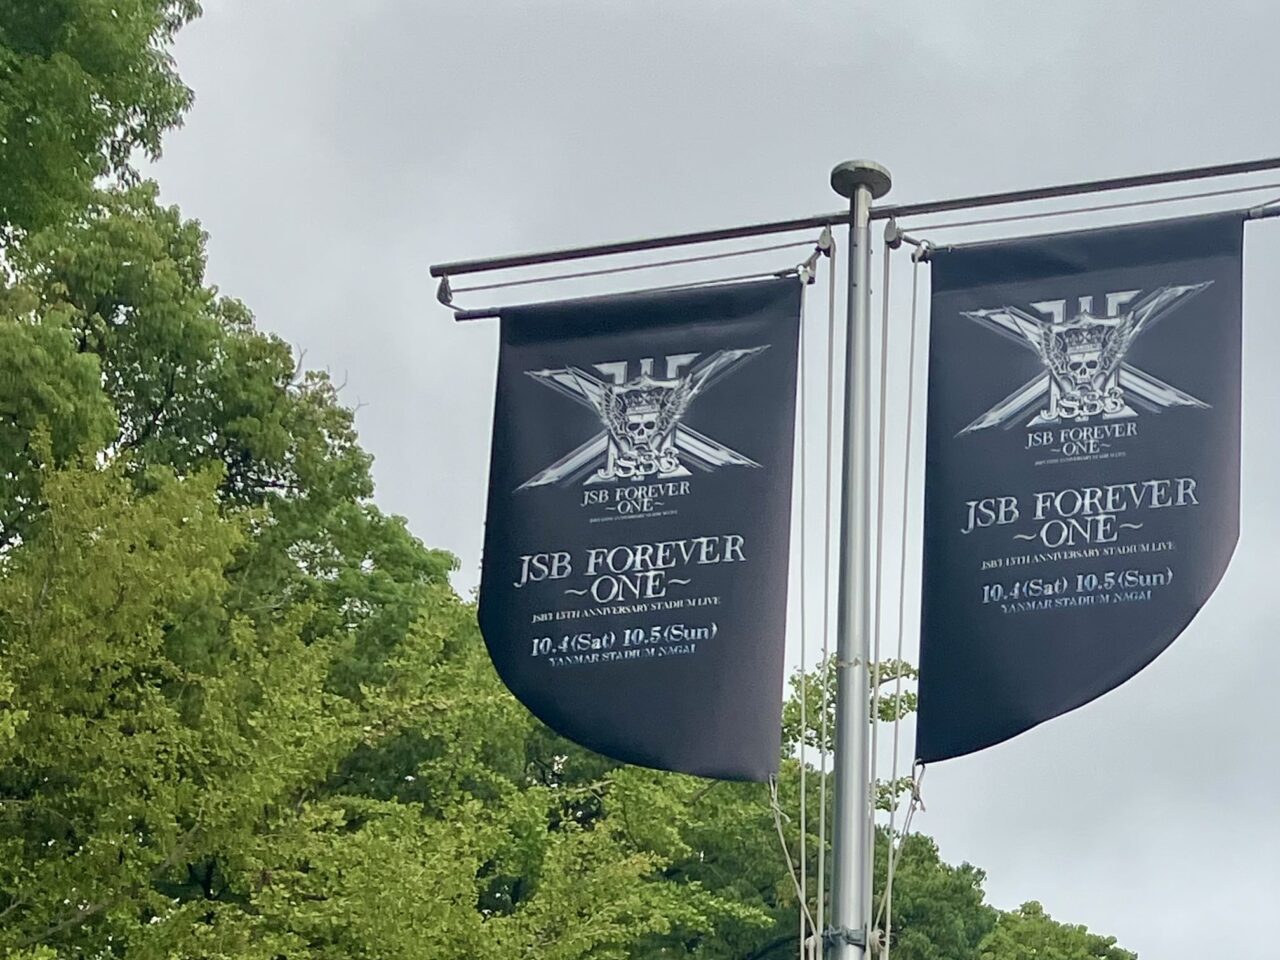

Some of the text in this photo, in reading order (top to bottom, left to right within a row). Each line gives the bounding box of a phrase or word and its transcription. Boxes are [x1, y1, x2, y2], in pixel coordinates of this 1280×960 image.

[1025, 422, 1138, 450] JSB FOREVER
[580, 481, 691, 507] JSB FOREVER
[961, 477, 1200, 534] JSB FOREVER
[513, 534, 747, 588] JSB FOREVER
[1031, 548, 1101, 564] ANNIVERSARY
[1102, 543, 1150, 557] STADIUM
[1150, 540, 1175, 552] LIVE
[1075, 567, 1174, 592] 10.5(Sun)
[581, 603, 649, 618] ANNIVERSARY
[650, 598, 697, 611] STADIUM
[697, 596, 721, 606] LIVE
[1000, 599, 1053, 614] YANMAR
[1055, 594, 1109, 608] STADIUM
[623, 622, 718, 647] 10.5(Sun)
[549, 652, 600, 667] YANMAR
[601, 647, 655, 662] STADIUM
